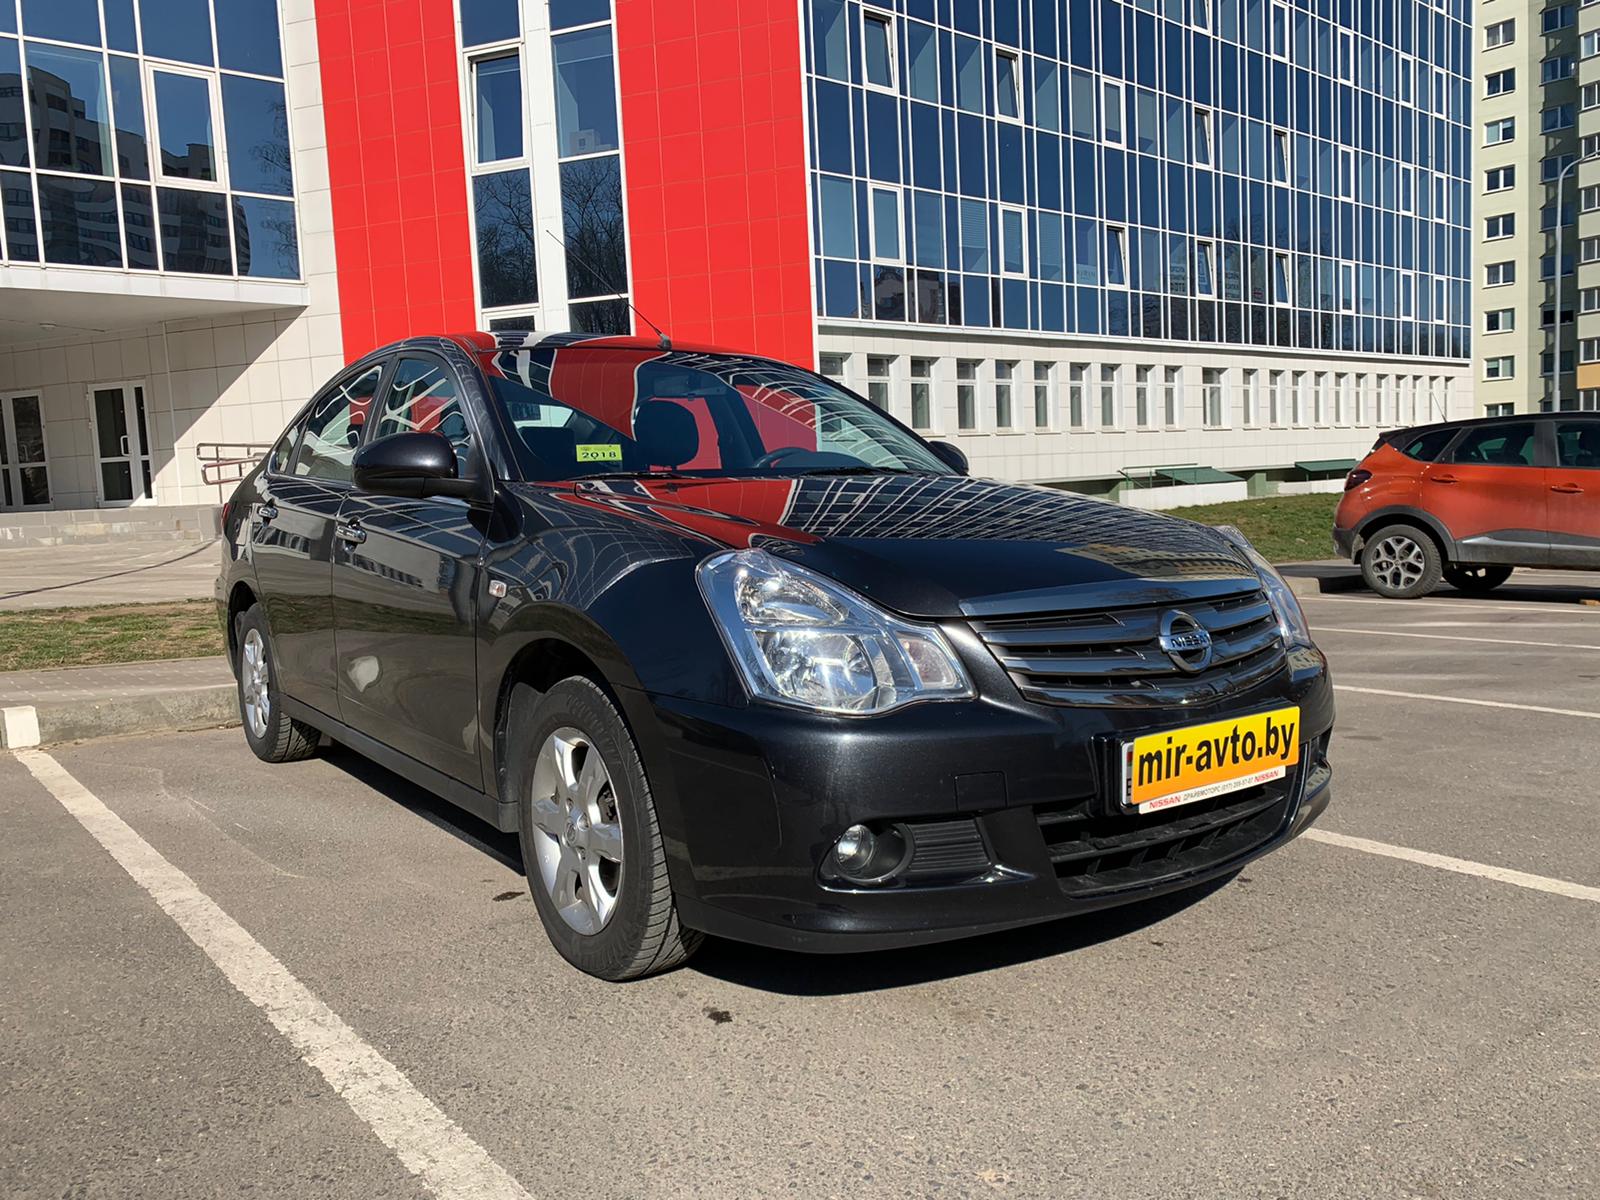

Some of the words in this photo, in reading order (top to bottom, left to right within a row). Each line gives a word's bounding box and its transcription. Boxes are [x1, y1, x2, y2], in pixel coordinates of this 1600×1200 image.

[1138, 717, 1295, 787] mir-avto.by
[1149, 795, 1181, 810] NISSAN
[1253, 769, 1279, 784] NISSAN
